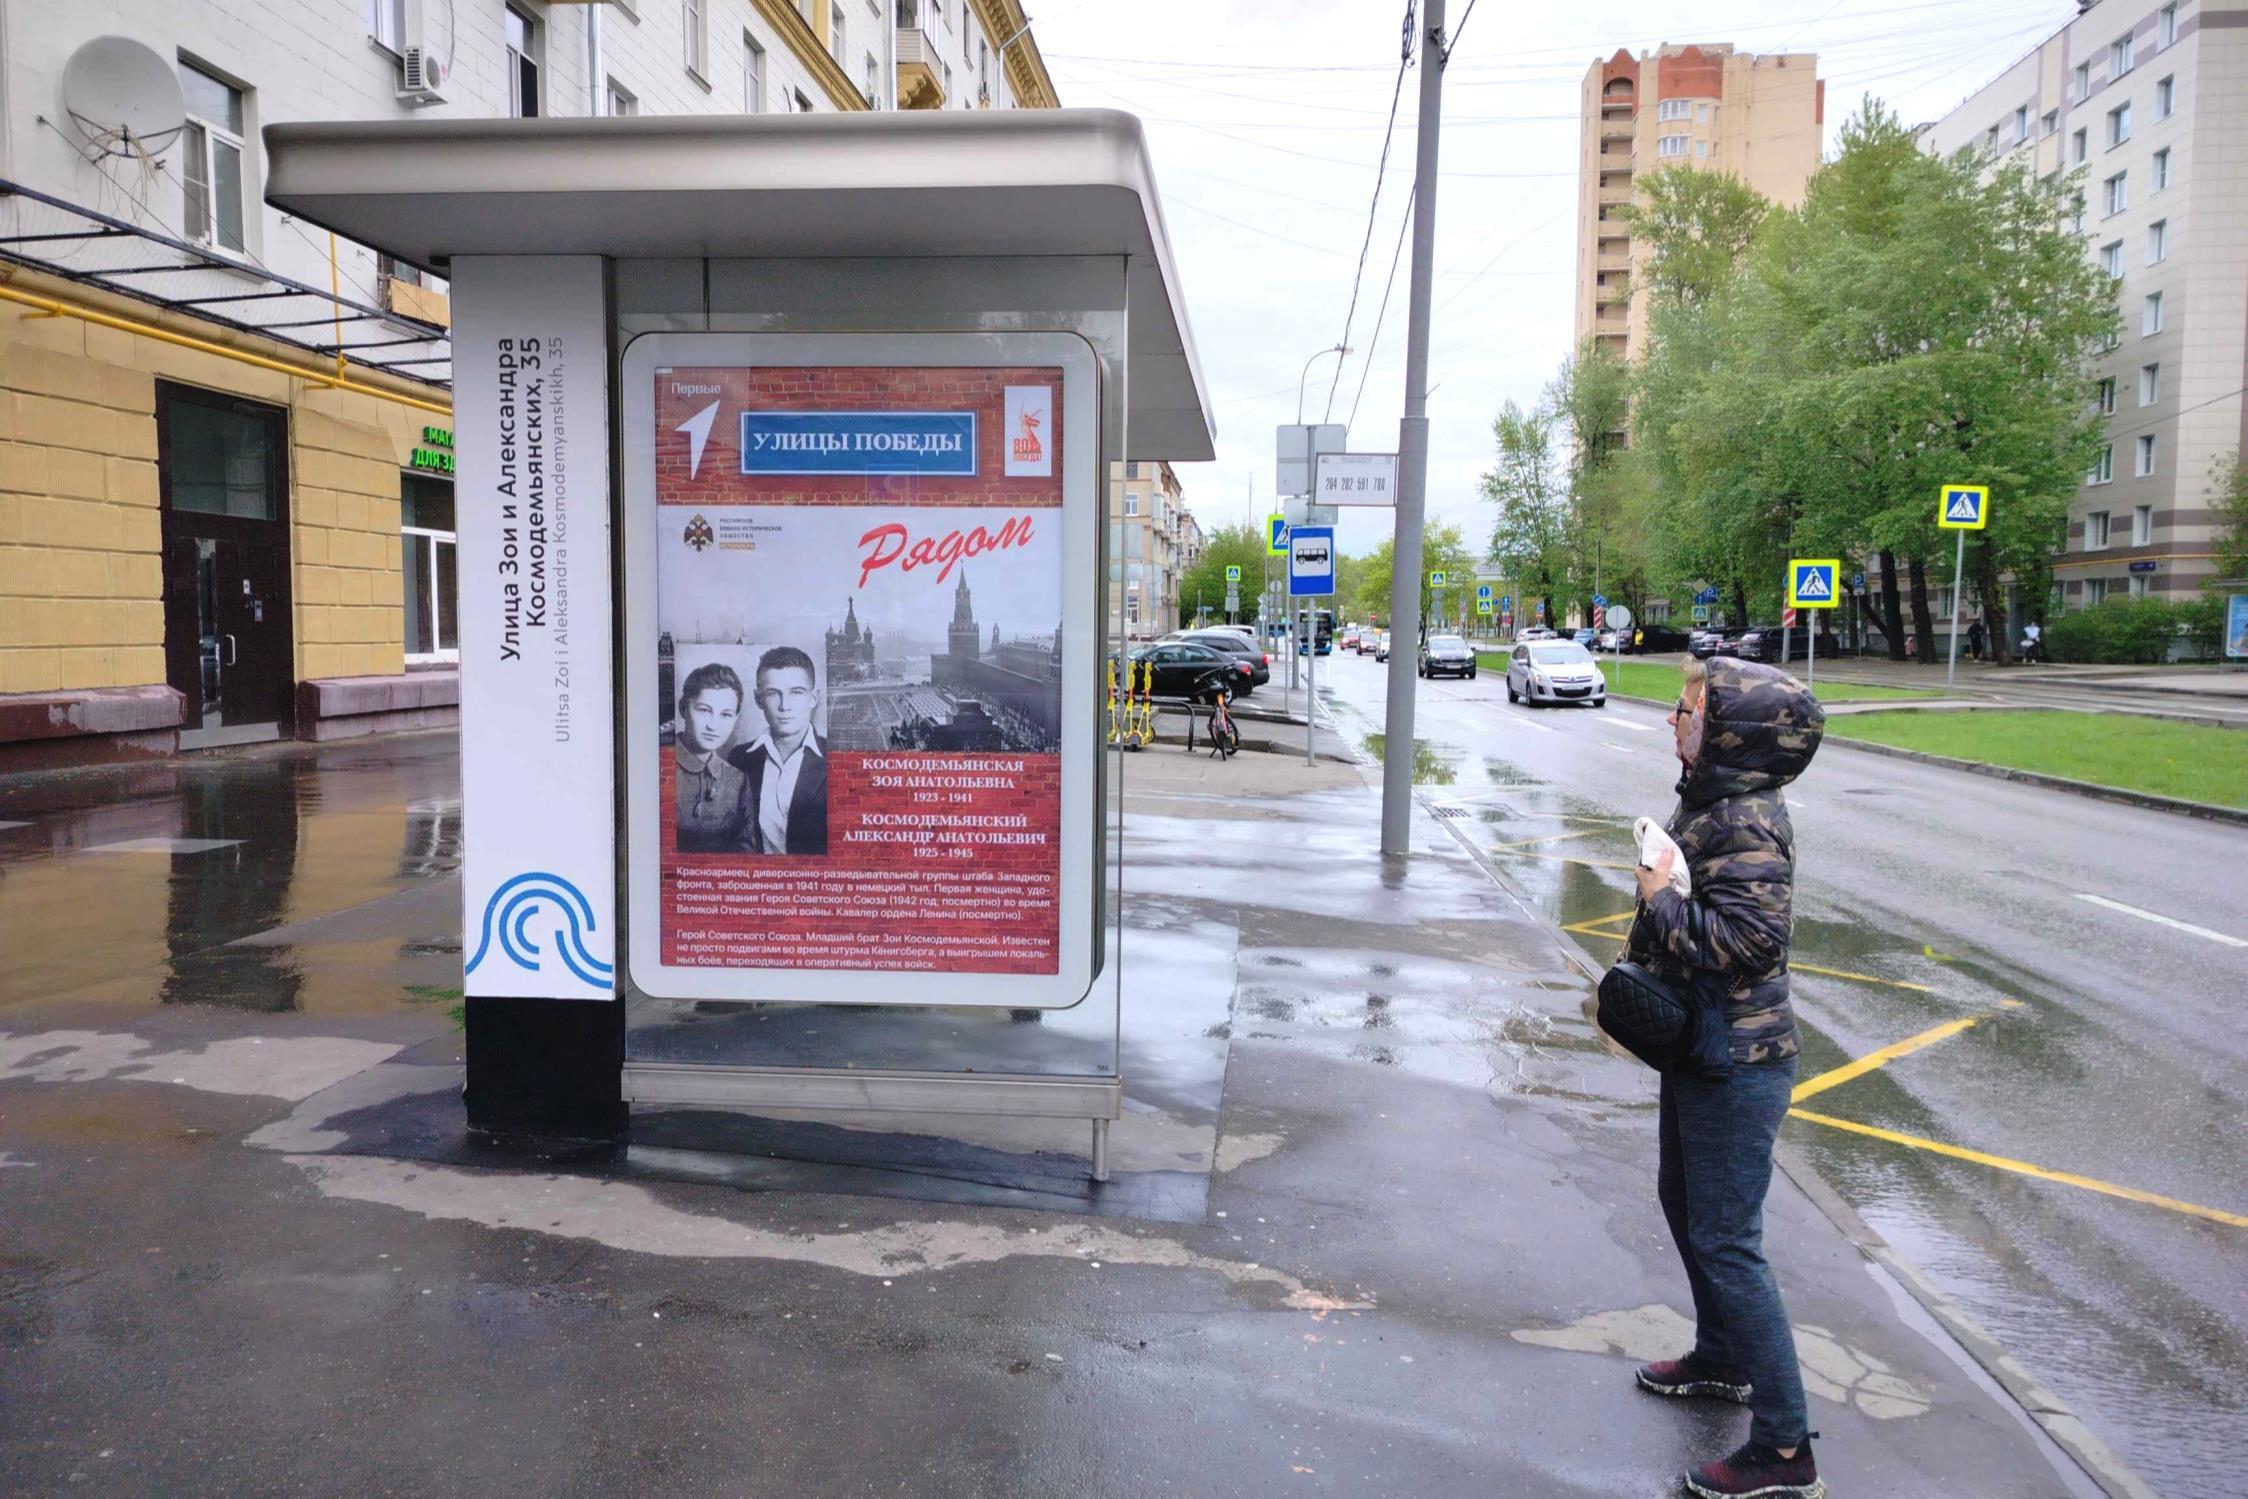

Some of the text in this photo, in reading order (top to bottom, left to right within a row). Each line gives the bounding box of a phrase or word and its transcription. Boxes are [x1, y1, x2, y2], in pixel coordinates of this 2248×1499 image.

[548, 337, 562, 359] 35
[671, 383, 721, 398] Первые
[753, 432, 962, 457] УЛИЦЫ ПОБЕДЫ
[416, 449, 440, 468] ДЛЯ
[548, 363, 567, 543] Kosmodemyanskikh,
[520, 337, 547, 626] Космодемьянских, 35
[1325, 476, 1337, 491] 204
[1341, 476, 1353, 491] 282
[1357, 476, 1369, 491] 591
[497, 338, 522, 661] Улица Зои и Александра
[857, 514, 1034, 588] Рядом
[552, 548, 568, 645] Aleksandra
[555, 661, 569, 688] Zoi
[555, 693, 570, 742] Ulitsa
[862, 758, 1024, 772] КОСМОДЕМЬЯНСКАЯ
[872, 776, 1015, 789] ЗОЯ АНАТОЛЬЕВНА
[913, 792, 938, 803] 1923
[948, 793, 973, 803] 1941
[862, 813, 1027, 828] КОСМОДЕМЬЯНСКИЙ
[843, 831, 1046, 845] АЛЕКСАНДР АНАТОЛЬЕВИЧ
[912, 848, 938, 858] 1925
[948, 848, 973, 858] 1945
[677, 867, 1050, 883] Красноармеец диверсионно-разведывательной группы штаба Западного
[677, 880, 714, 890] фронта,
[717, 880, 784, 892] заброшенная
[796, 881, 818, 891] 1941
[821, 883, 844, 893] году
[856, 883, 906, 893] немецкий
[910, 884, 931, 892] тыл.
[934, 883, 971, 895] Первая
[975, 885, 1024, 896] женщина,
[1027, 887, 1050, 896] удо-
[677, 893, 722, 902] стоенная
[724, 894, 758, 902] звания
[761, 893, 790, 904] Героя
[793, 893, 850, 904] Советского
[853, 895, 886, 904] Союза
[942, 897, 1000, 908] посмертно)
[1004, 899, 1016, 907] во
[1018, 899, 1050, 909] время
[677, 904, 1024, 920] Великой Отечественной войны. Кавалер ордена Ленина (посмертно).
[677, 929, 706, 940] Герой
[708, 930, 765, 940] Советского
[805, 932, 854, 943] Младший
[857, 933, 880, 944] брат
[883, 933, 901, 943] Зои
[904, 934, 1000, 945] Космодемьянской.
[1002, 936, 1050, 945] Известен
[690, 944, 725, 953] просто
[727, 944, 780, 953] подвигами
[797, 946, 829, 955] время
[830, 946, 869, 956] штурма
[946, 949, 1007, 959] выигрышем
[1010, 950, 1050, 958] локаль-
[677, 957, 696, 965] ных
[726, 957, 793, 968] переходящих
[804, 959, 871, 968] оперативный
[874, 960, 902, 969] успех
[905, 958, 936, 968] войск.
